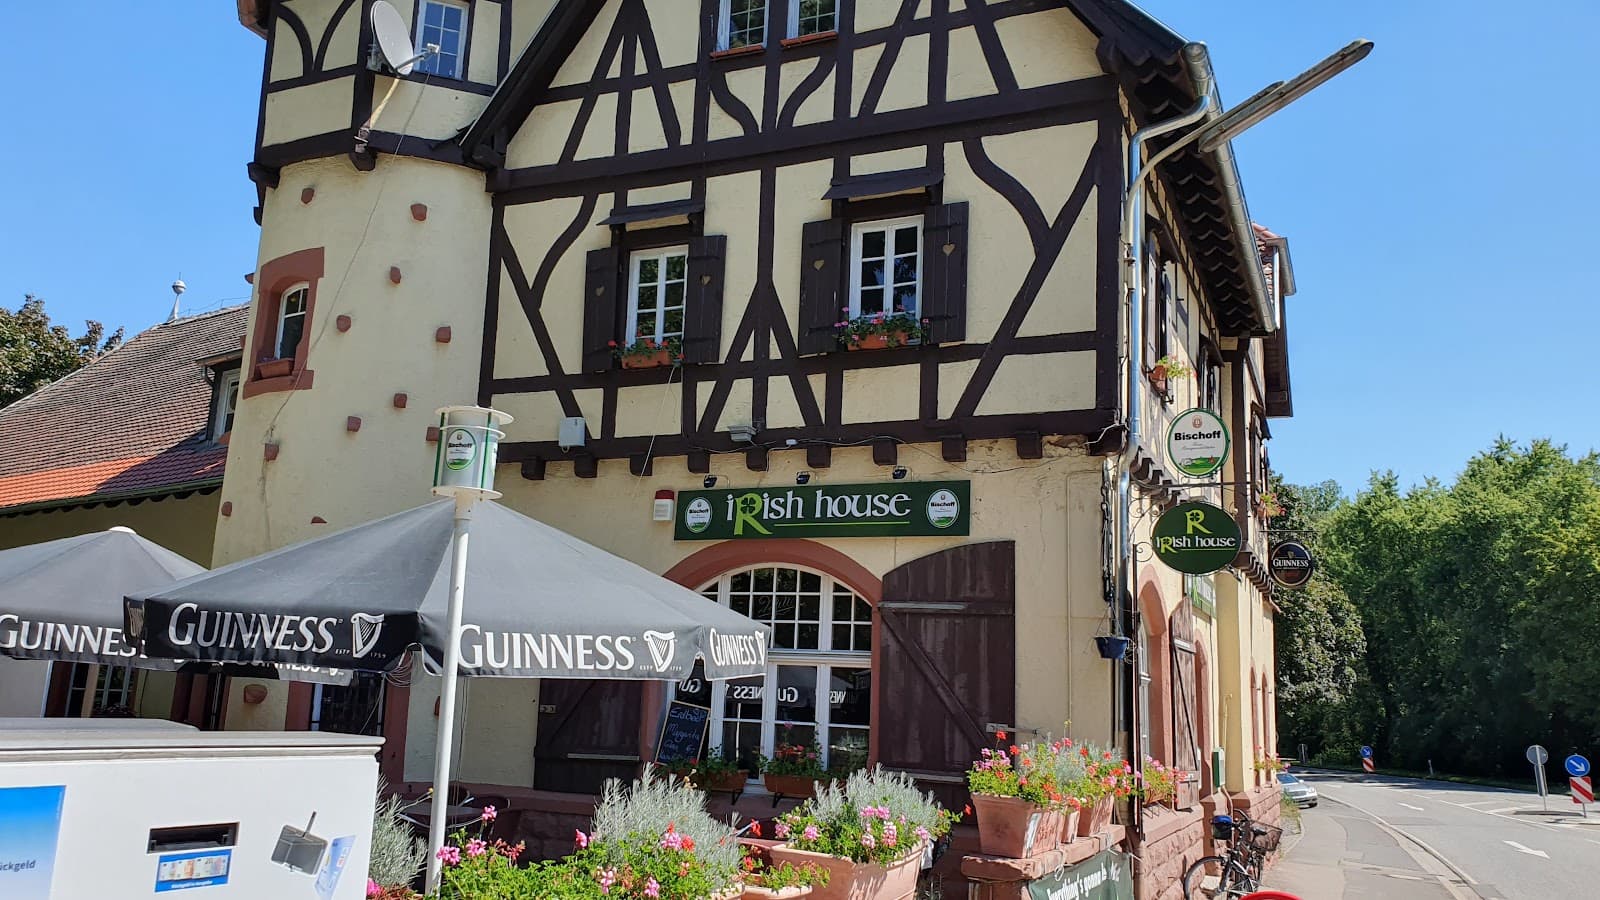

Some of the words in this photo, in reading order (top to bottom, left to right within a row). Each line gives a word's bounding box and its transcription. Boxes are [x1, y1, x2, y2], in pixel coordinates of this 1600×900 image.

[1174, 430, 1221, 441] Bischoff
[726, 490, 804, 536] iRish
[815, 489, 912, 519] house
[1195, 535, 1236, 548] house
[1272, 558, 1309, 567] GUINNESS
[0, 614, 149, 658] GUINNES
[168, 602, 338, 654] GUINNESS
[458, 624, 635, 671] GUINNESS
[710, 627, 757, 667] GUINNESS
